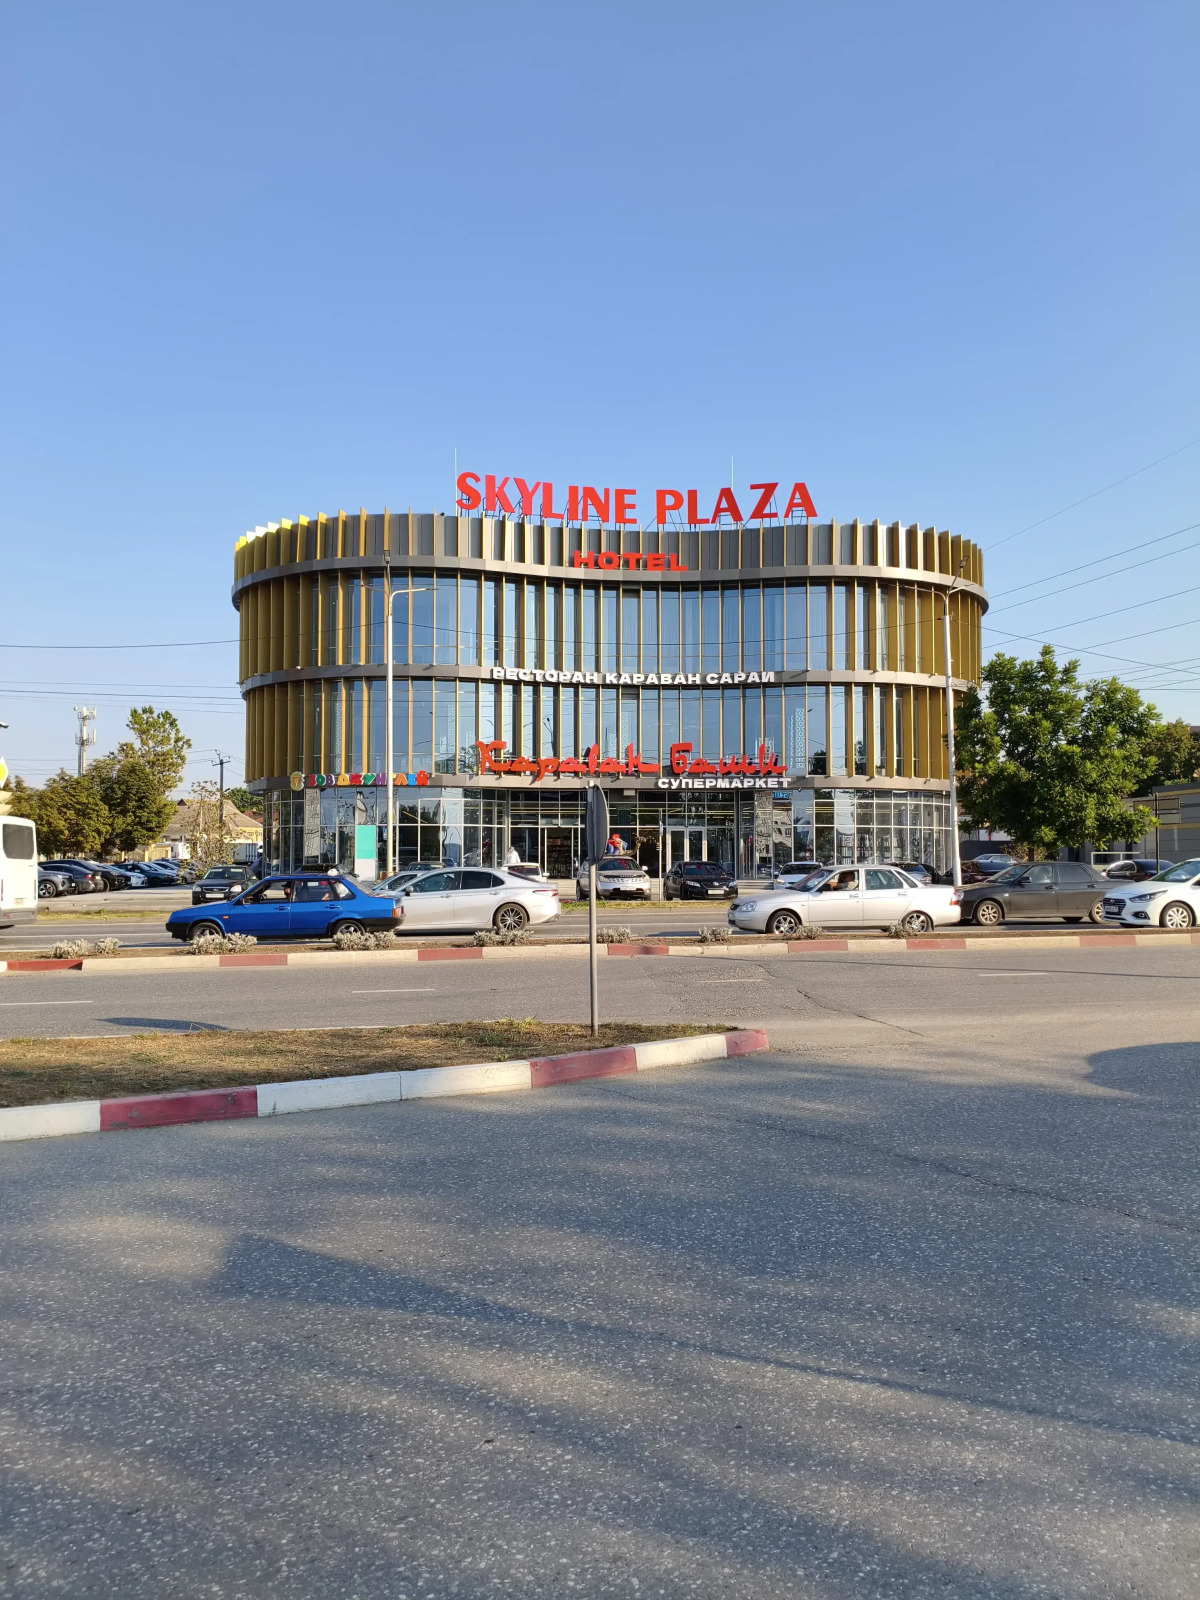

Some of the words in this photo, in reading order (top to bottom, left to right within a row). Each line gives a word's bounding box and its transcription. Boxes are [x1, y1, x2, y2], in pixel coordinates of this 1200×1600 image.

[456, 472, 637, 524] SKYLINE
[656, 483, 817, 524] PLAZA
[573, 550, 689, 571] HOTEL
[493, 667, 598, 684] РЕСТОРАН
[605, 672, 702, 685] КАРАВАН
[670, 743, 787, 774] Баши
[308, 773, 335, 786] ЗОВ
[337, 770, 430, 786] ДЖУНЛЕЙ
[657, 777, 792, 789] СУПЕРМАРКЕТ
